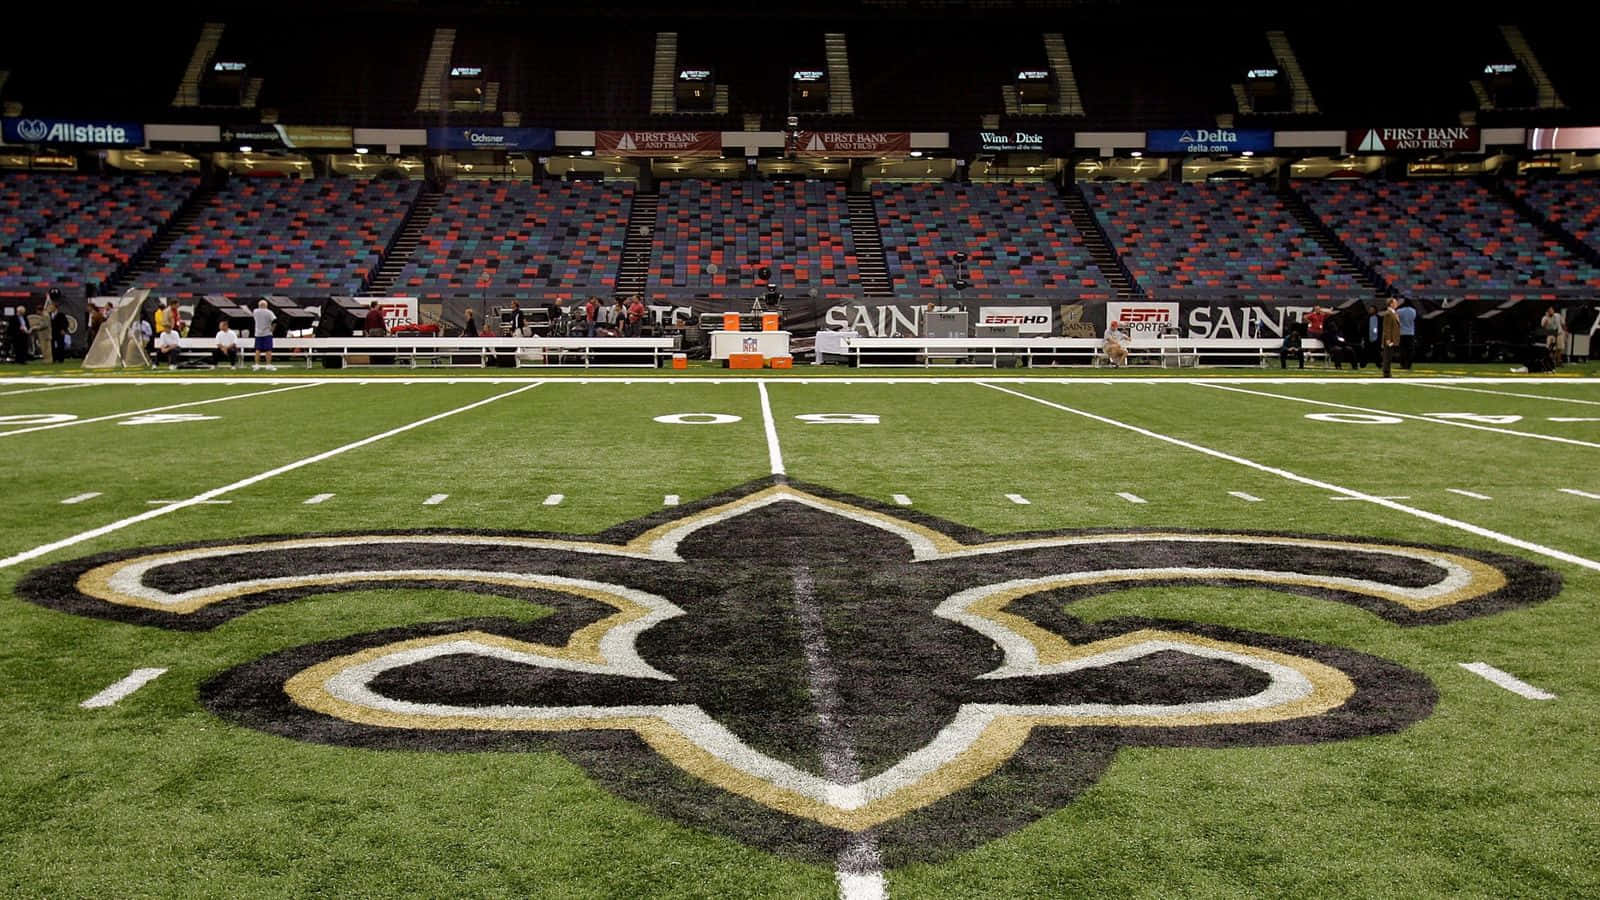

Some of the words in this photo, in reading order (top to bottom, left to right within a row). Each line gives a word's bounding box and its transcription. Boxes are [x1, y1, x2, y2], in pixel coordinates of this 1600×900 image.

[47, 122, 126, 143] Allstate
[471, 133, 504, 142] Ochsner
[634, 132, 667, 142] FIRST
[668, 132, 699, 143] BANK
[824, 132, 855, 143] FIRST
[857, 133, 888, 143] BANK
[980, 132, 1008, 143] Winn
[1016, 132, 1043, 143] Dixie
[1196, 129, 1237, 142] Delta
[1383, 128, 1426, 140] FIRST
[1428, 128, 1470, 140] BANK
[645, 141, 663, 149] AND
[664, 141, 688, 149] TRUST
[834, 142, 852, 150] AND
[853, 142, 877, 150] TRUST
[1187, 143, 1229, 152] delta.com
[1396, 140, 1419, 149] AND
[1421, 140, 1455, 149] TRUST
[1119, 308, 1170, 321] ESPN
[1187, 306, 1314, 339] SAINT
